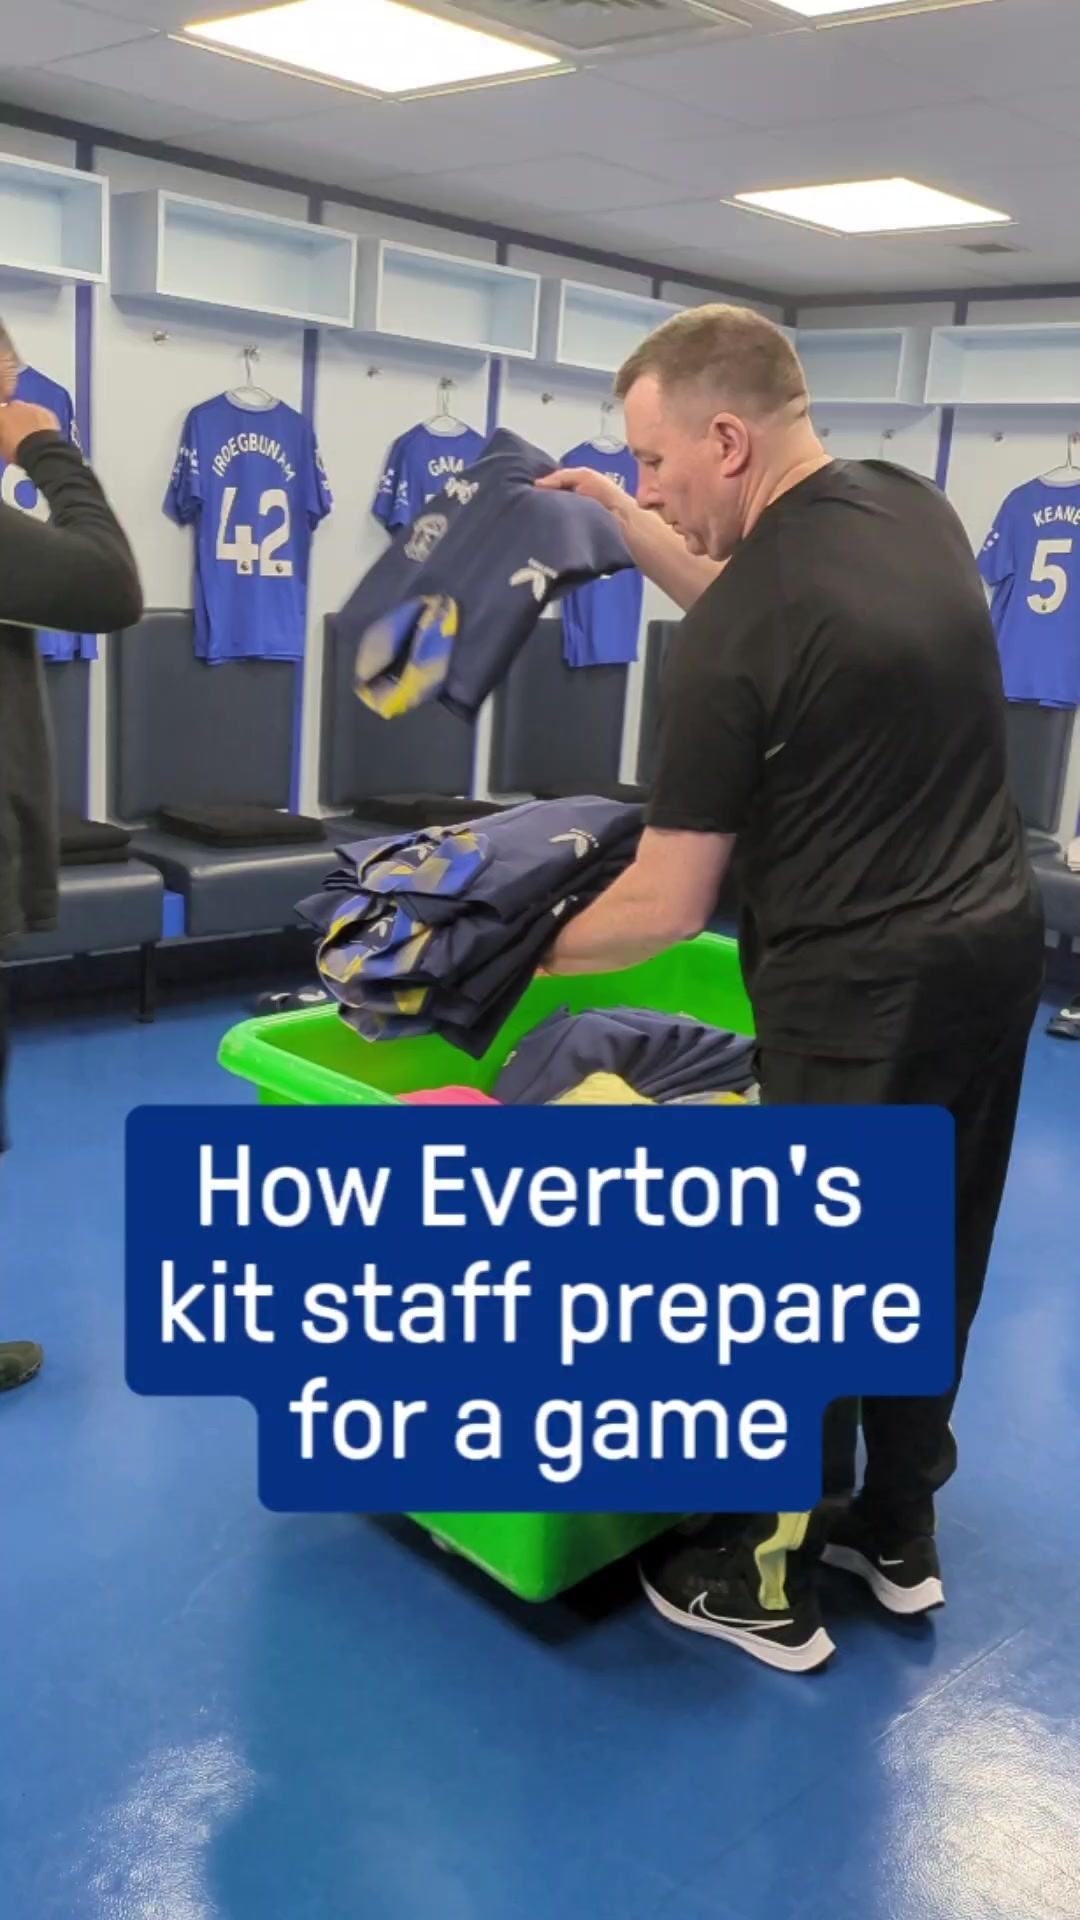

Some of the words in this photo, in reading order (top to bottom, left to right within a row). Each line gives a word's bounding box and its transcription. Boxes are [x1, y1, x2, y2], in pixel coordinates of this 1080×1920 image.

[212, 433, 296, 481] IROEGBUNAM
[216, 487, 293, 576] 42
[1027, 539, 1073, 614] 5
